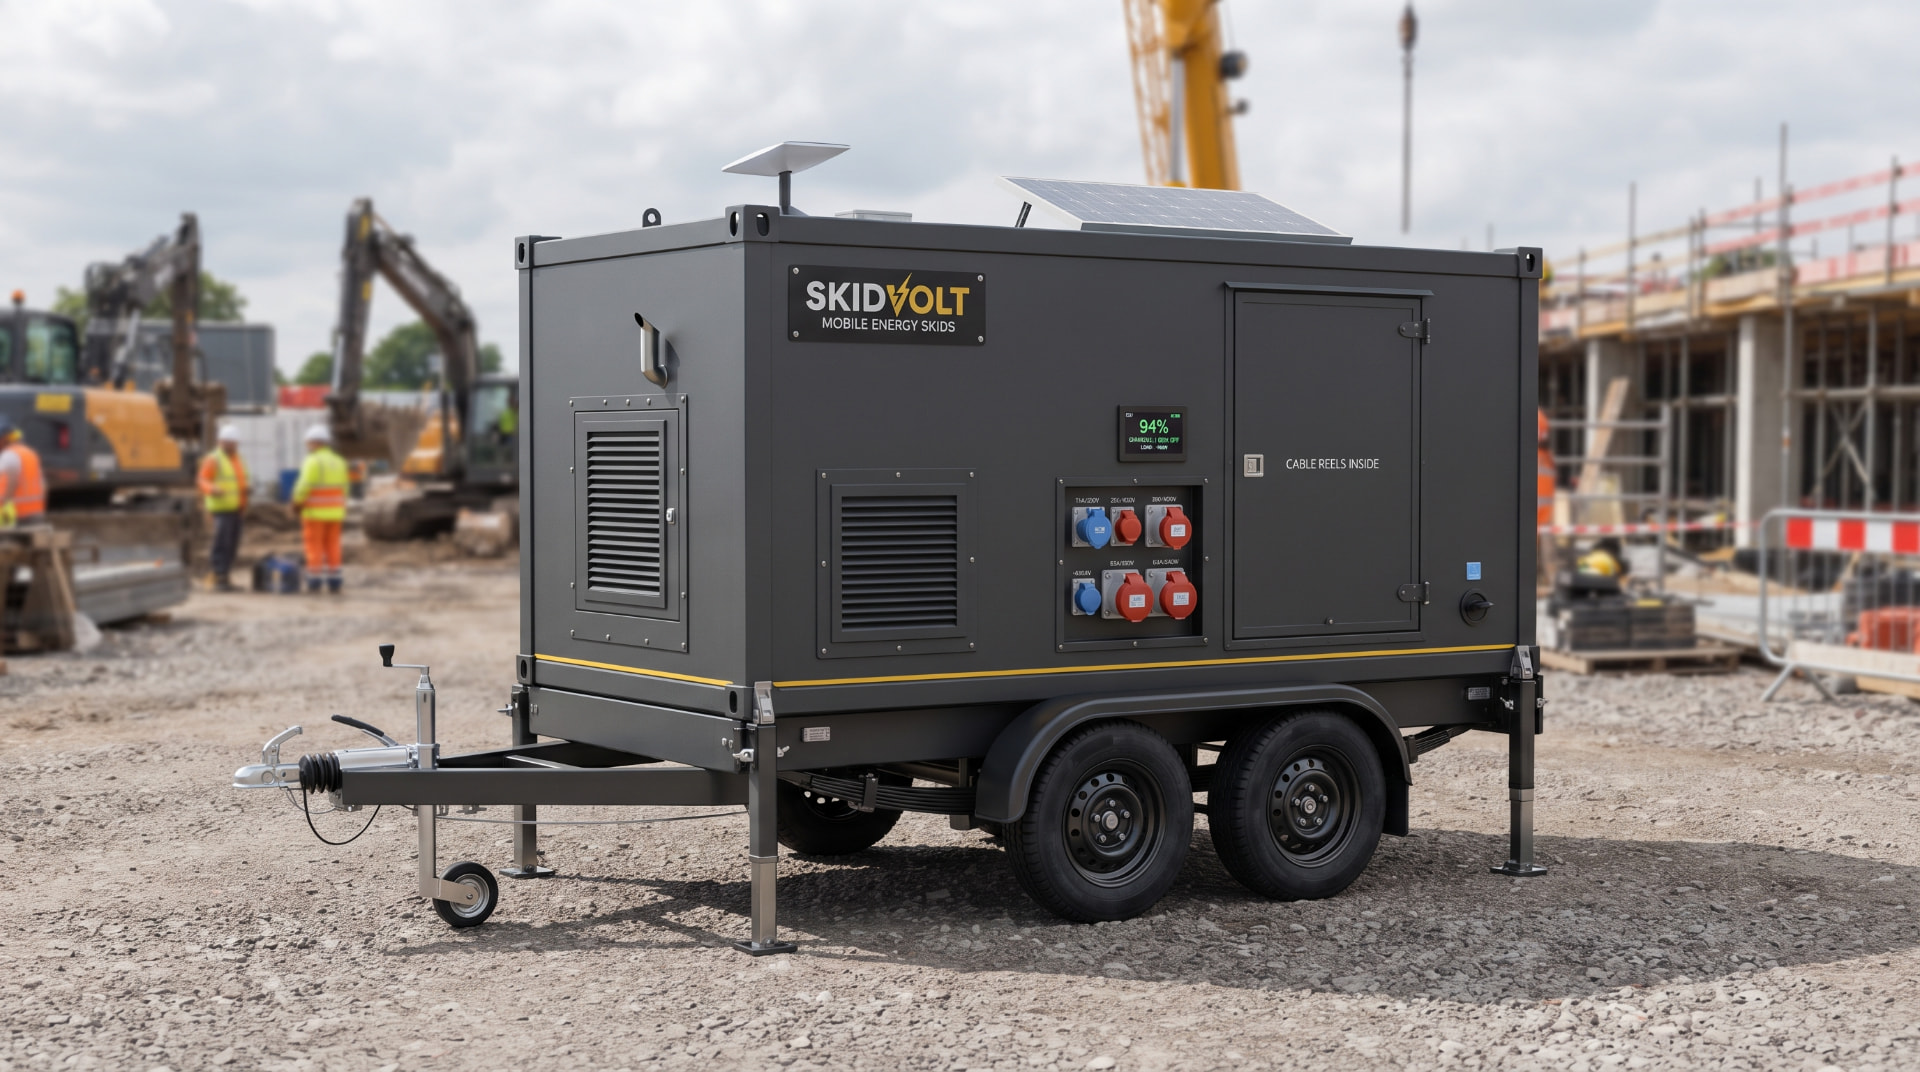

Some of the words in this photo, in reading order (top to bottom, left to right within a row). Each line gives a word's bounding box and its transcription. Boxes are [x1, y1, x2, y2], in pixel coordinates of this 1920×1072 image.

[805, 272, 970, 317] SKIDVOLT
[822, 317, 868, 330] MOBILE
[871, 318, 919, 332] ENERGY
[921, 320, 956, 333] SKIDS
[1139, 418, 1169, 434] 94%
[1286, 458, 1317, 469] CABLE
[1318, 458, 1347, 469] REELS
[1348, 458, 1380, 469] INSIDE
